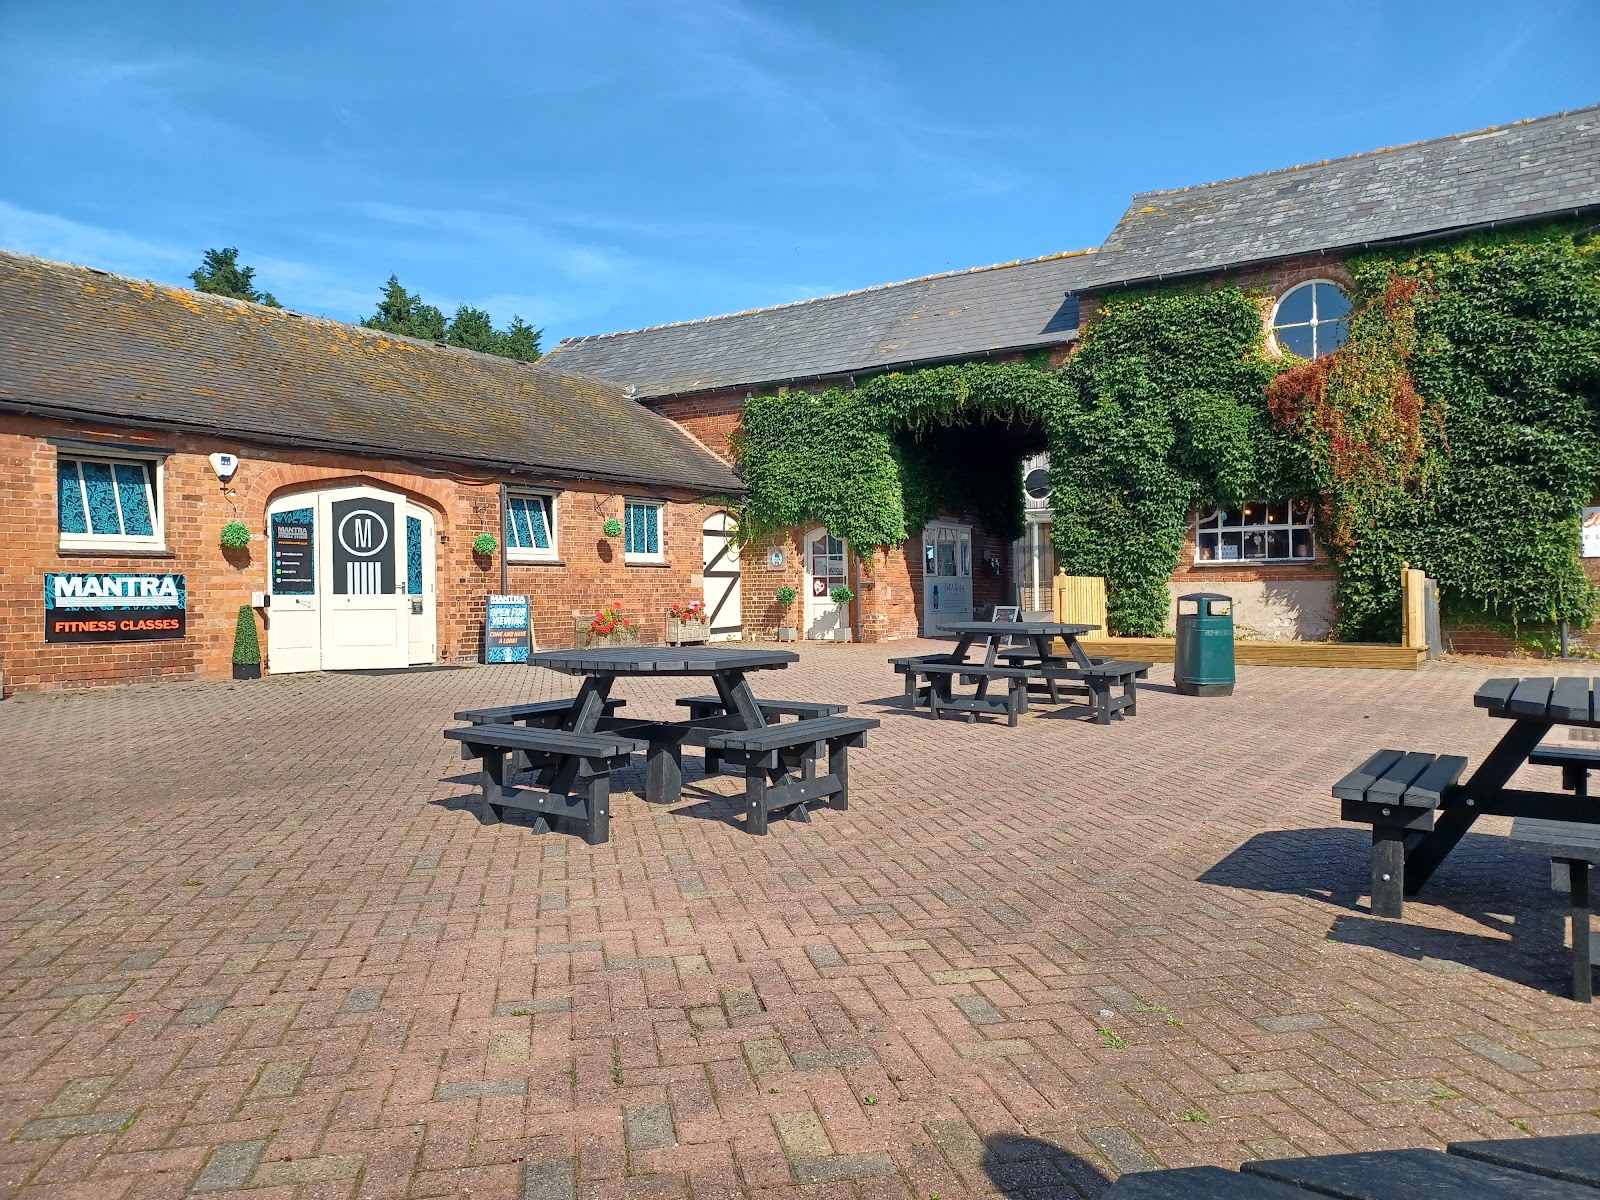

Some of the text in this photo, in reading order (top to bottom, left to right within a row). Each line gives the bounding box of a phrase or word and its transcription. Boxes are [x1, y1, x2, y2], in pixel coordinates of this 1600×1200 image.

[278, 526, 308, 534] MANTRA
[355, 519, 372, 548] M
[54, 576, 178, 597] MANTRA
[490, 608, 526, 616] OPEN FOR
[55, 619, 180, 633] FITNESS CLASSES
[493, 617, 525, 625] VIEWING
